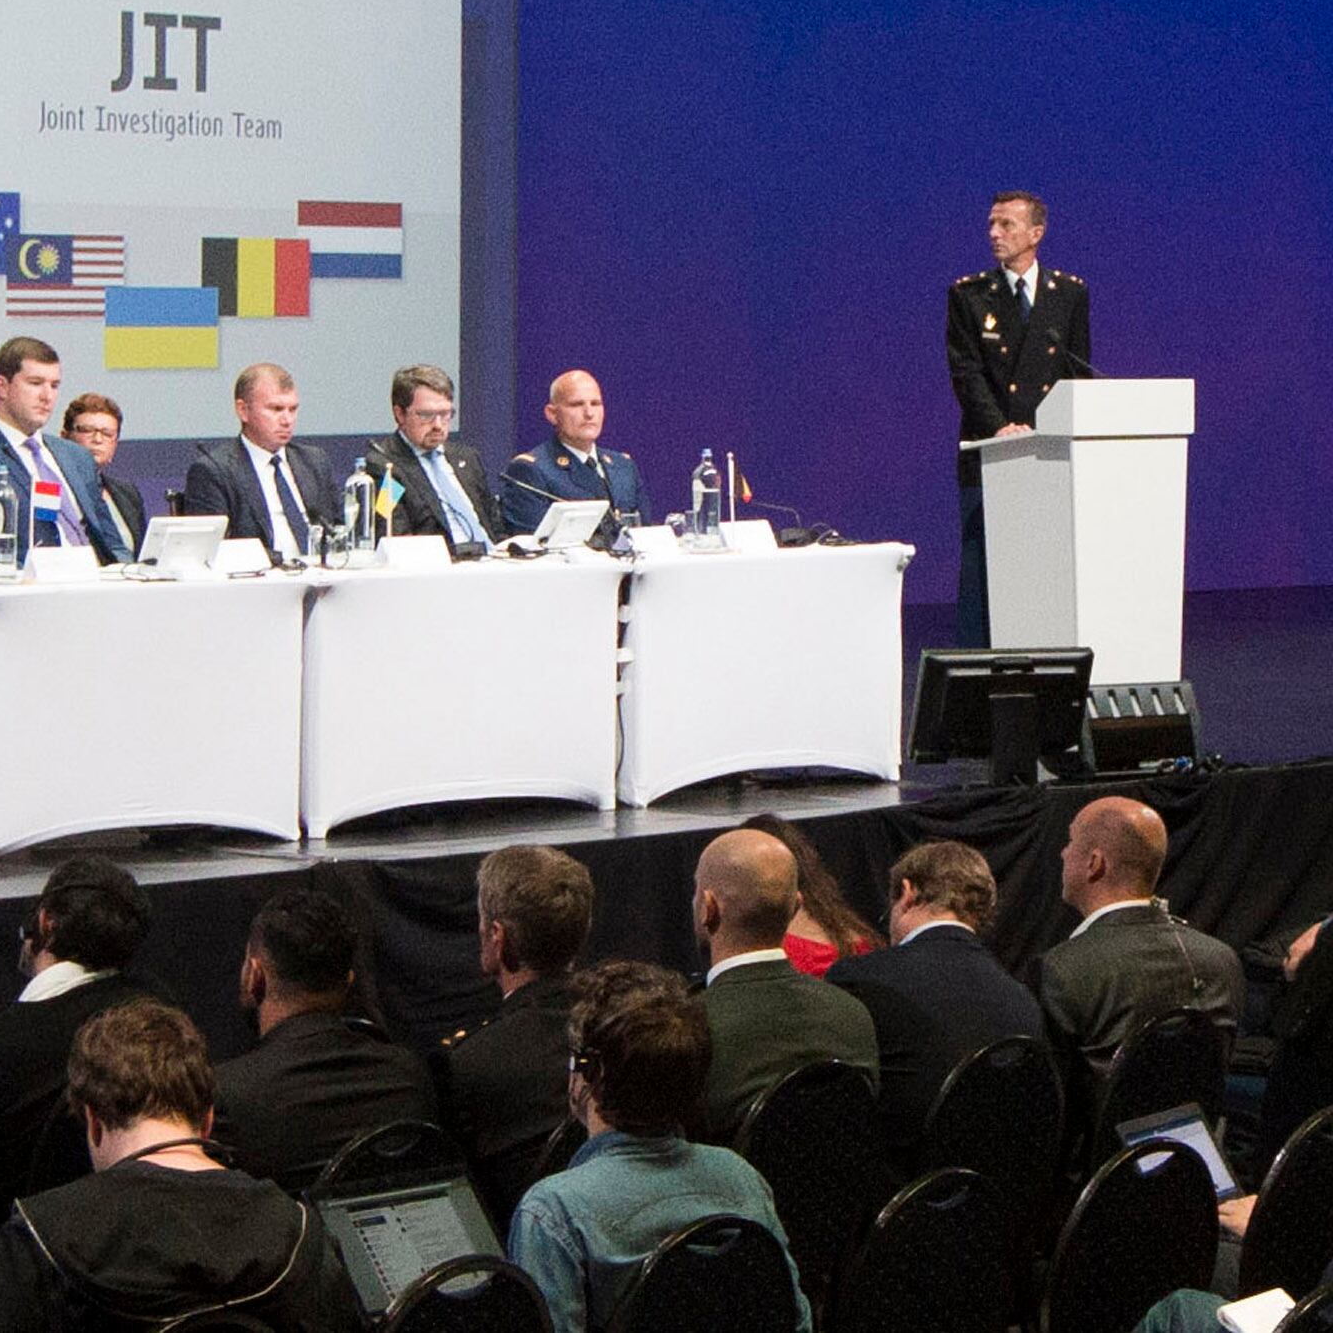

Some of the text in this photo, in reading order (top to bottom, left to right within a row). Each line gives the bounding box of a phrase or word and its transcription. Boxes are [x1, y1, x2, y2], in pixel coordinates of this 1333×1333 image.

[110, 10, 222, 93] JIT
[38, 101, 283, 141] Joint Investigation Team
